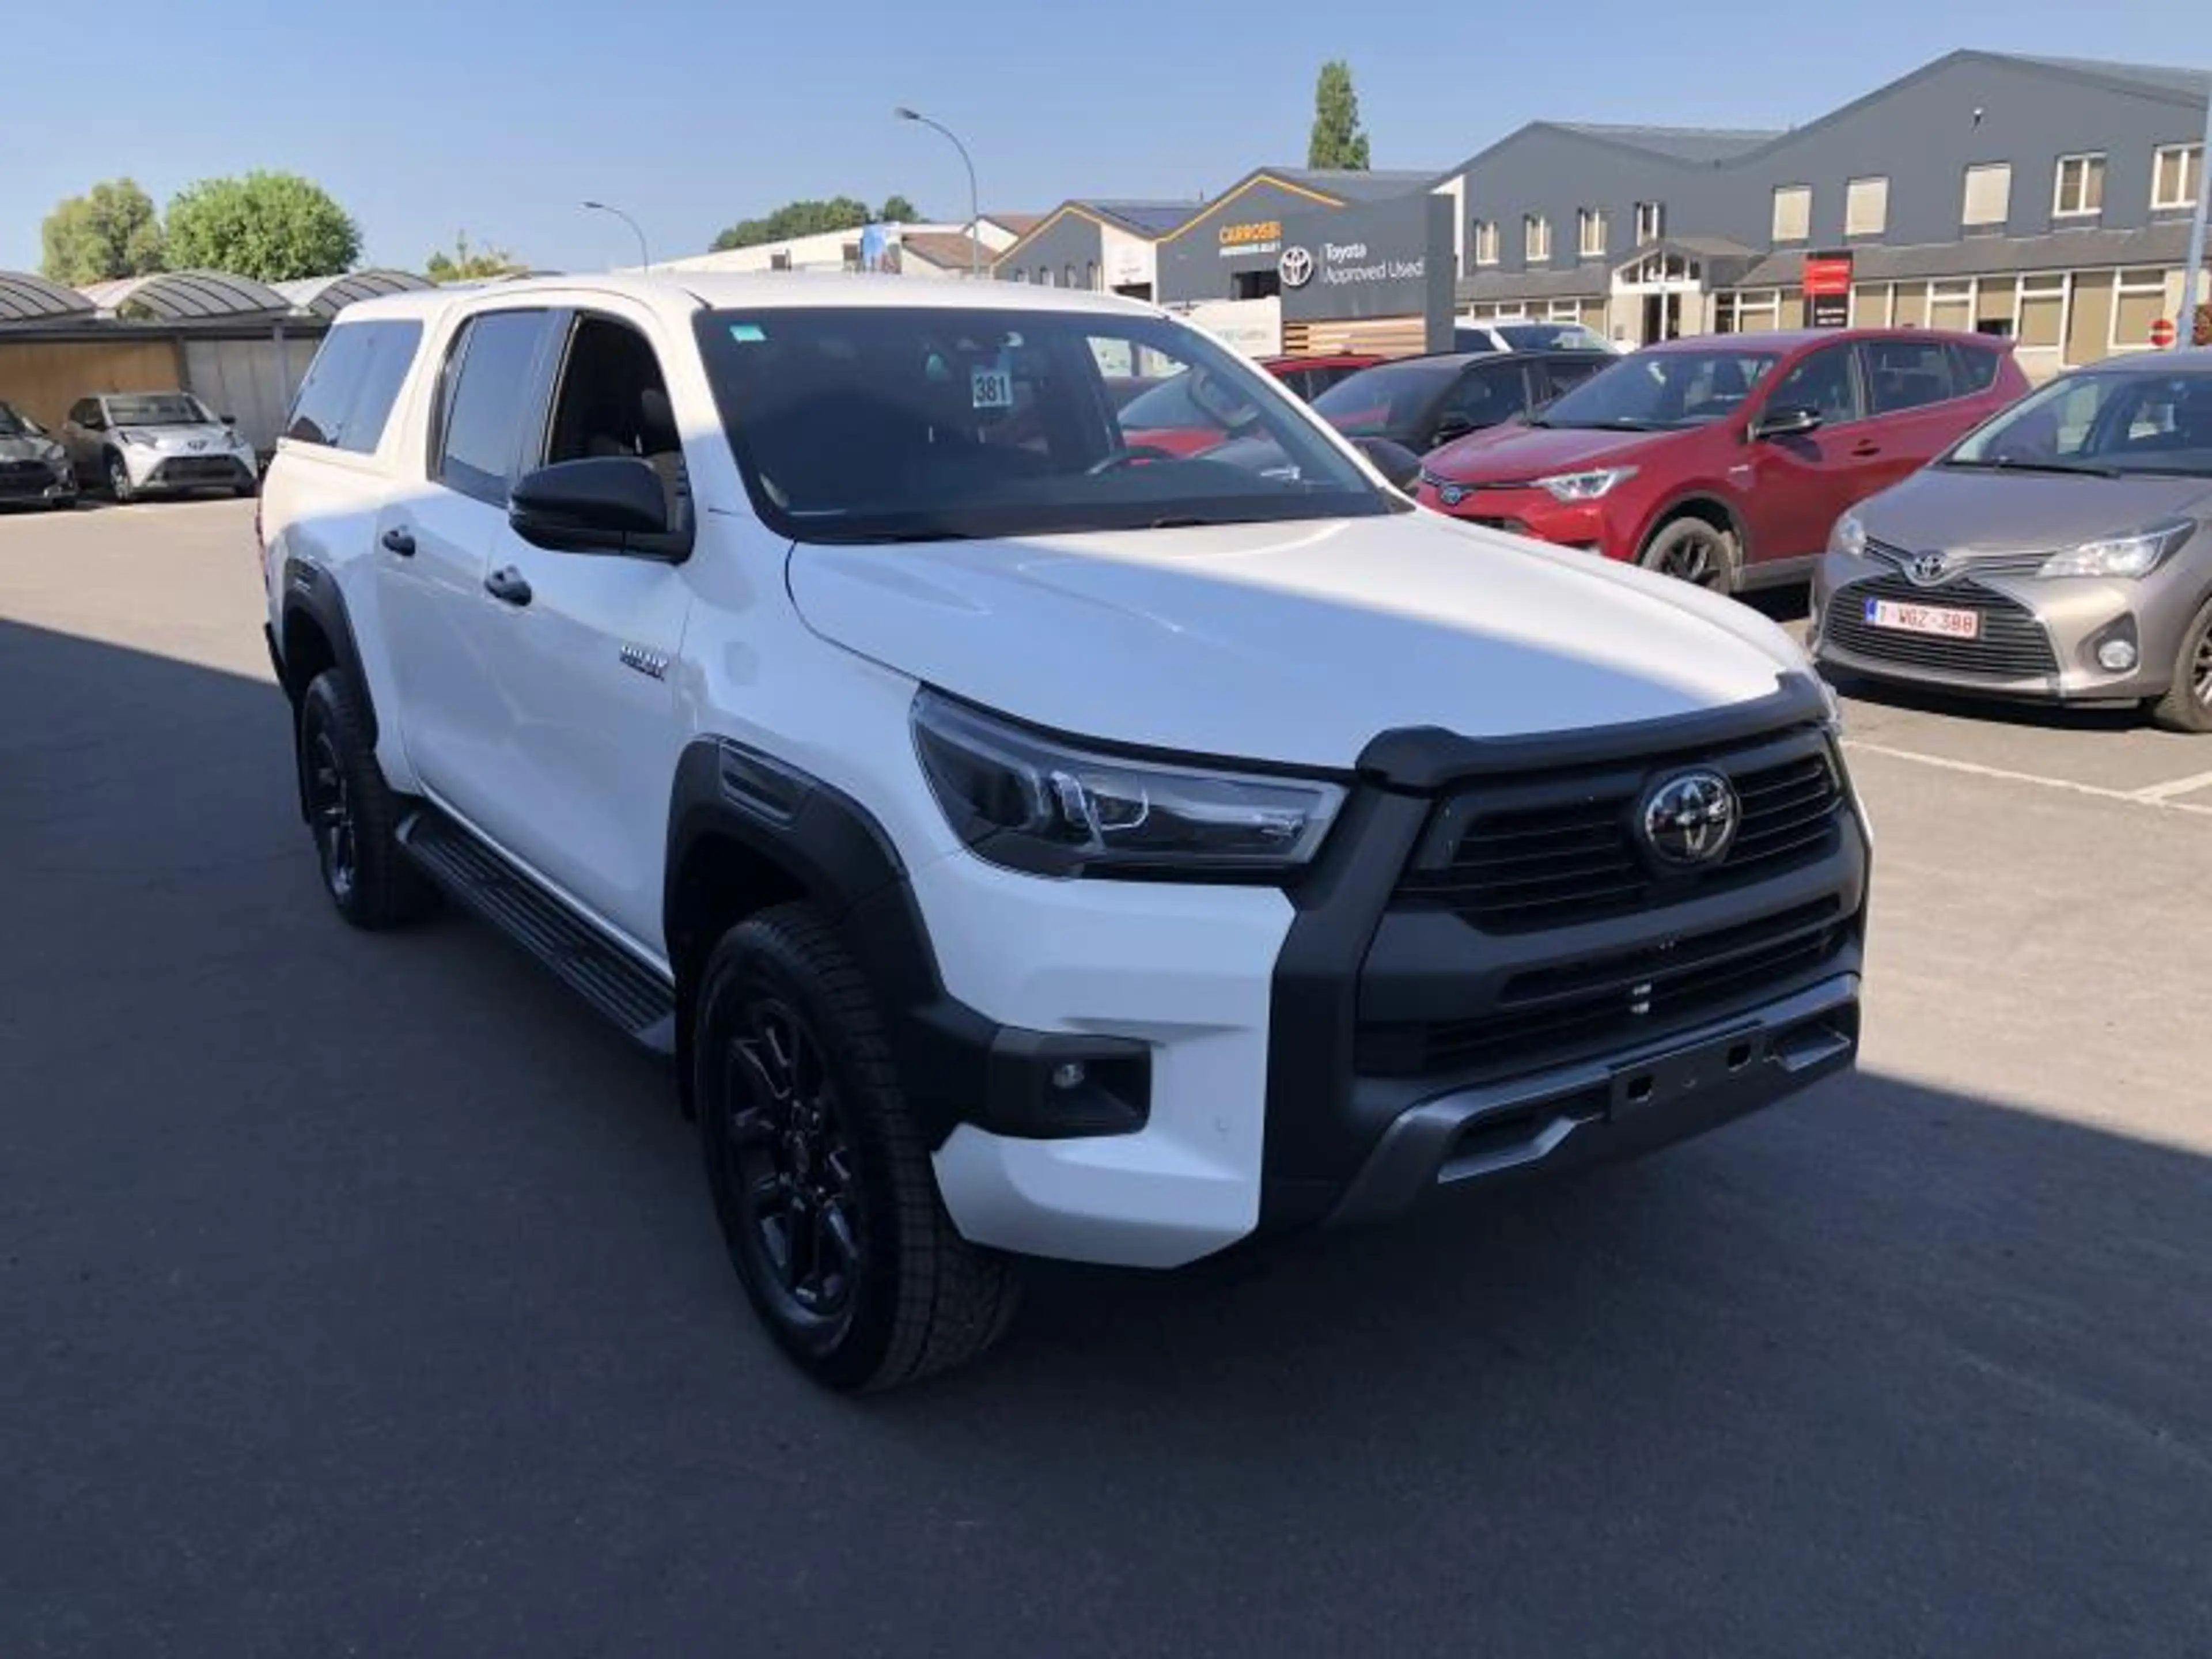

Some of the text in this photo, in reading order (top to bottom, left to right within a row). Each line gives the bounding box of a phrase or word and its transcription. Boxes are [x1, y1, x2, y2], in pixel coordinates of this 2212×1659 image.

[1325, 243, 1367, 264] Toyota
[1325, 256, 1425, 286] Approved Used
[975, 375, 1005, 402] 381
